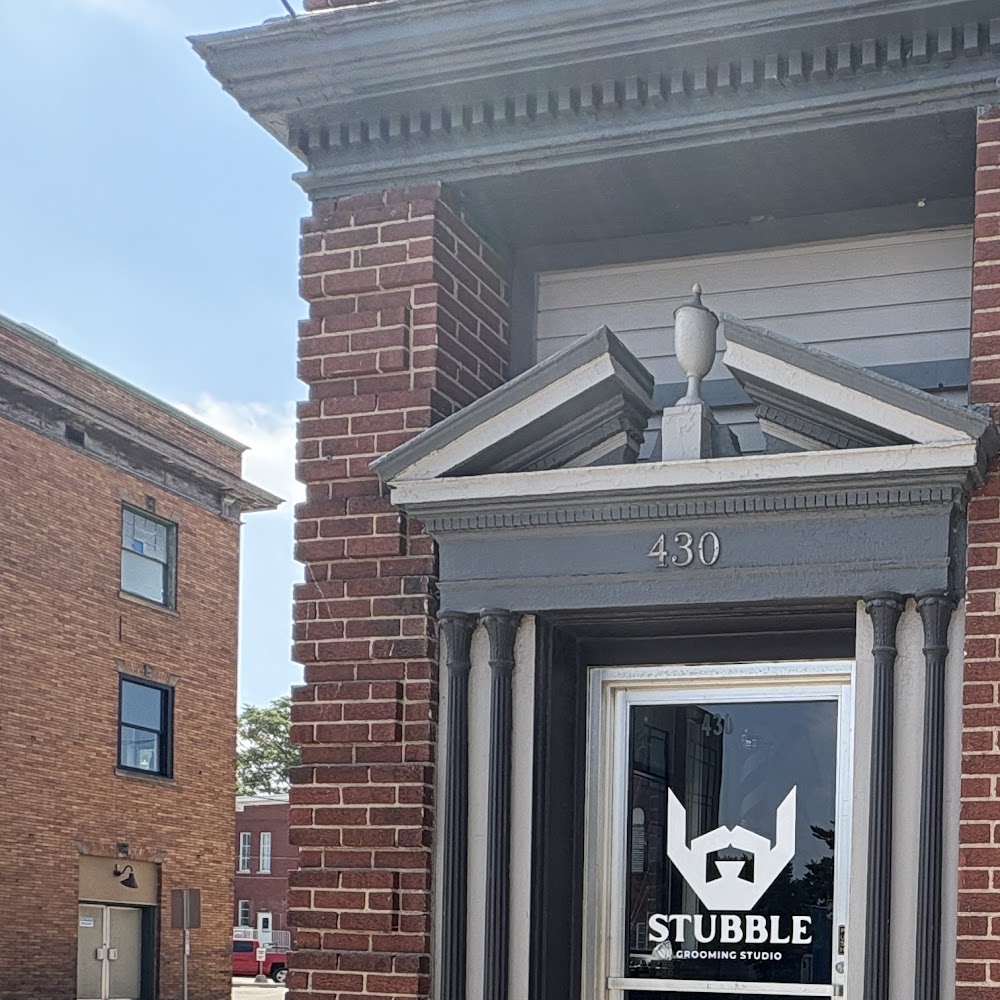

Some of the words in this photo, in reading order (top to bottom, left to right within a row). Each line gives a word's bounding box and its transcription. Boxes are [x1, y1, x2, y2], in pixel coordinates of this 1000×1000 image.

[647, 531, 721, 568] 430
[701, 712, 734, 737] 430
[648, 913, 813, 945] STUBBLE
[676, 950, 737, 960] GROOMING
[740, 951, 783, 961] STUDIO
